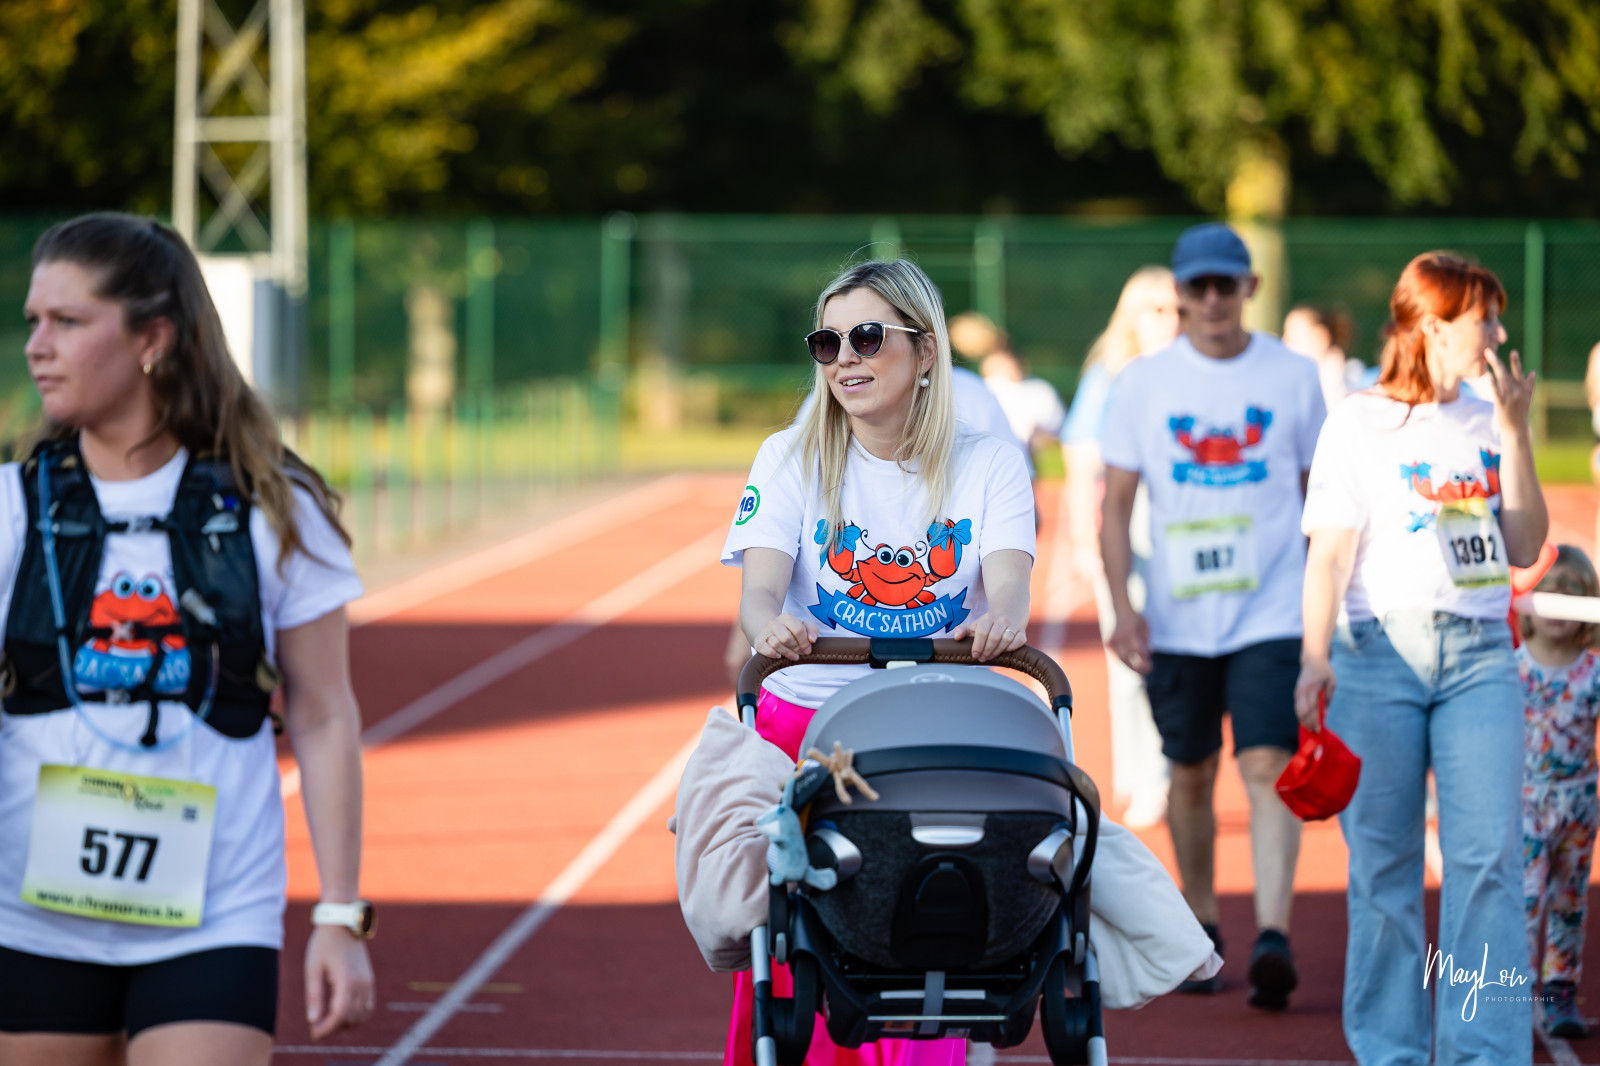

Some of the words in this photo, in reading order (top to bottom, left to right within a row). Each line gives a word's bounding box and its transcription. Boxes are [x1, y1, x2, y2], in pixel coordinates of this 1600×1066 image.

[1450, 535, 1498, 566] 1392
[833, 600, 948, 633] CRAC'SATHON
[79, 827, 159, 881] 577
